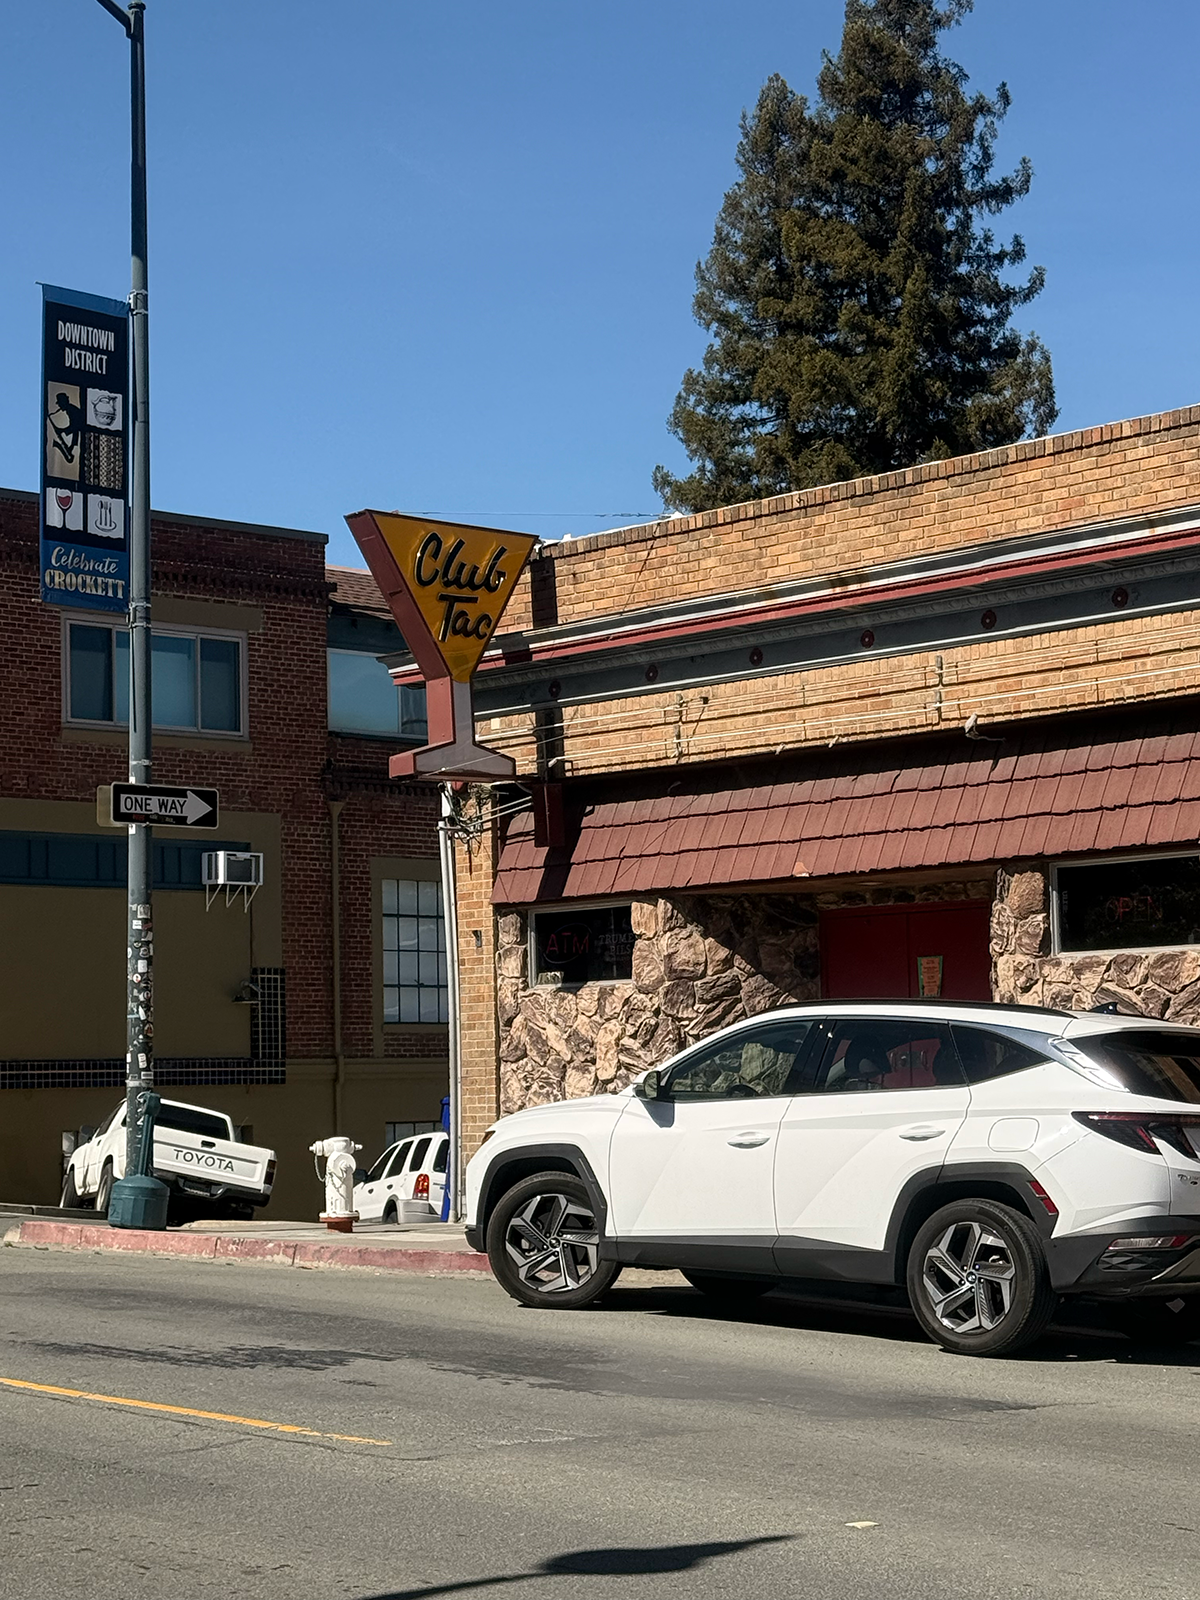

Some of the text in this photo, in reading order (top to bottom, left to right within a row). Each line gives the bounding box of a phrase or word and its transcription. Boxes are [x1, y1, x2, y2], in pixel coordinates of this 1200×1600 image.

[57, 320, 115, 352] DOWNTOWN
[65, 346, 108, 375] DISTRICT
[51, 546, 119, 574] Celebrate
[414, 531, 508, 593] Club
[44, 568, 125, 599] CROCKETT
[437, 592, 493, 643] Tac
[124, 796, 187, 814] ONE WAY
[545, 931, 590, 954] ATM
[598, 932, 635, 945] TRUME
[609, 944, 631, 955] PILS
[173, 1148, 235, 1172] TOYOTA
